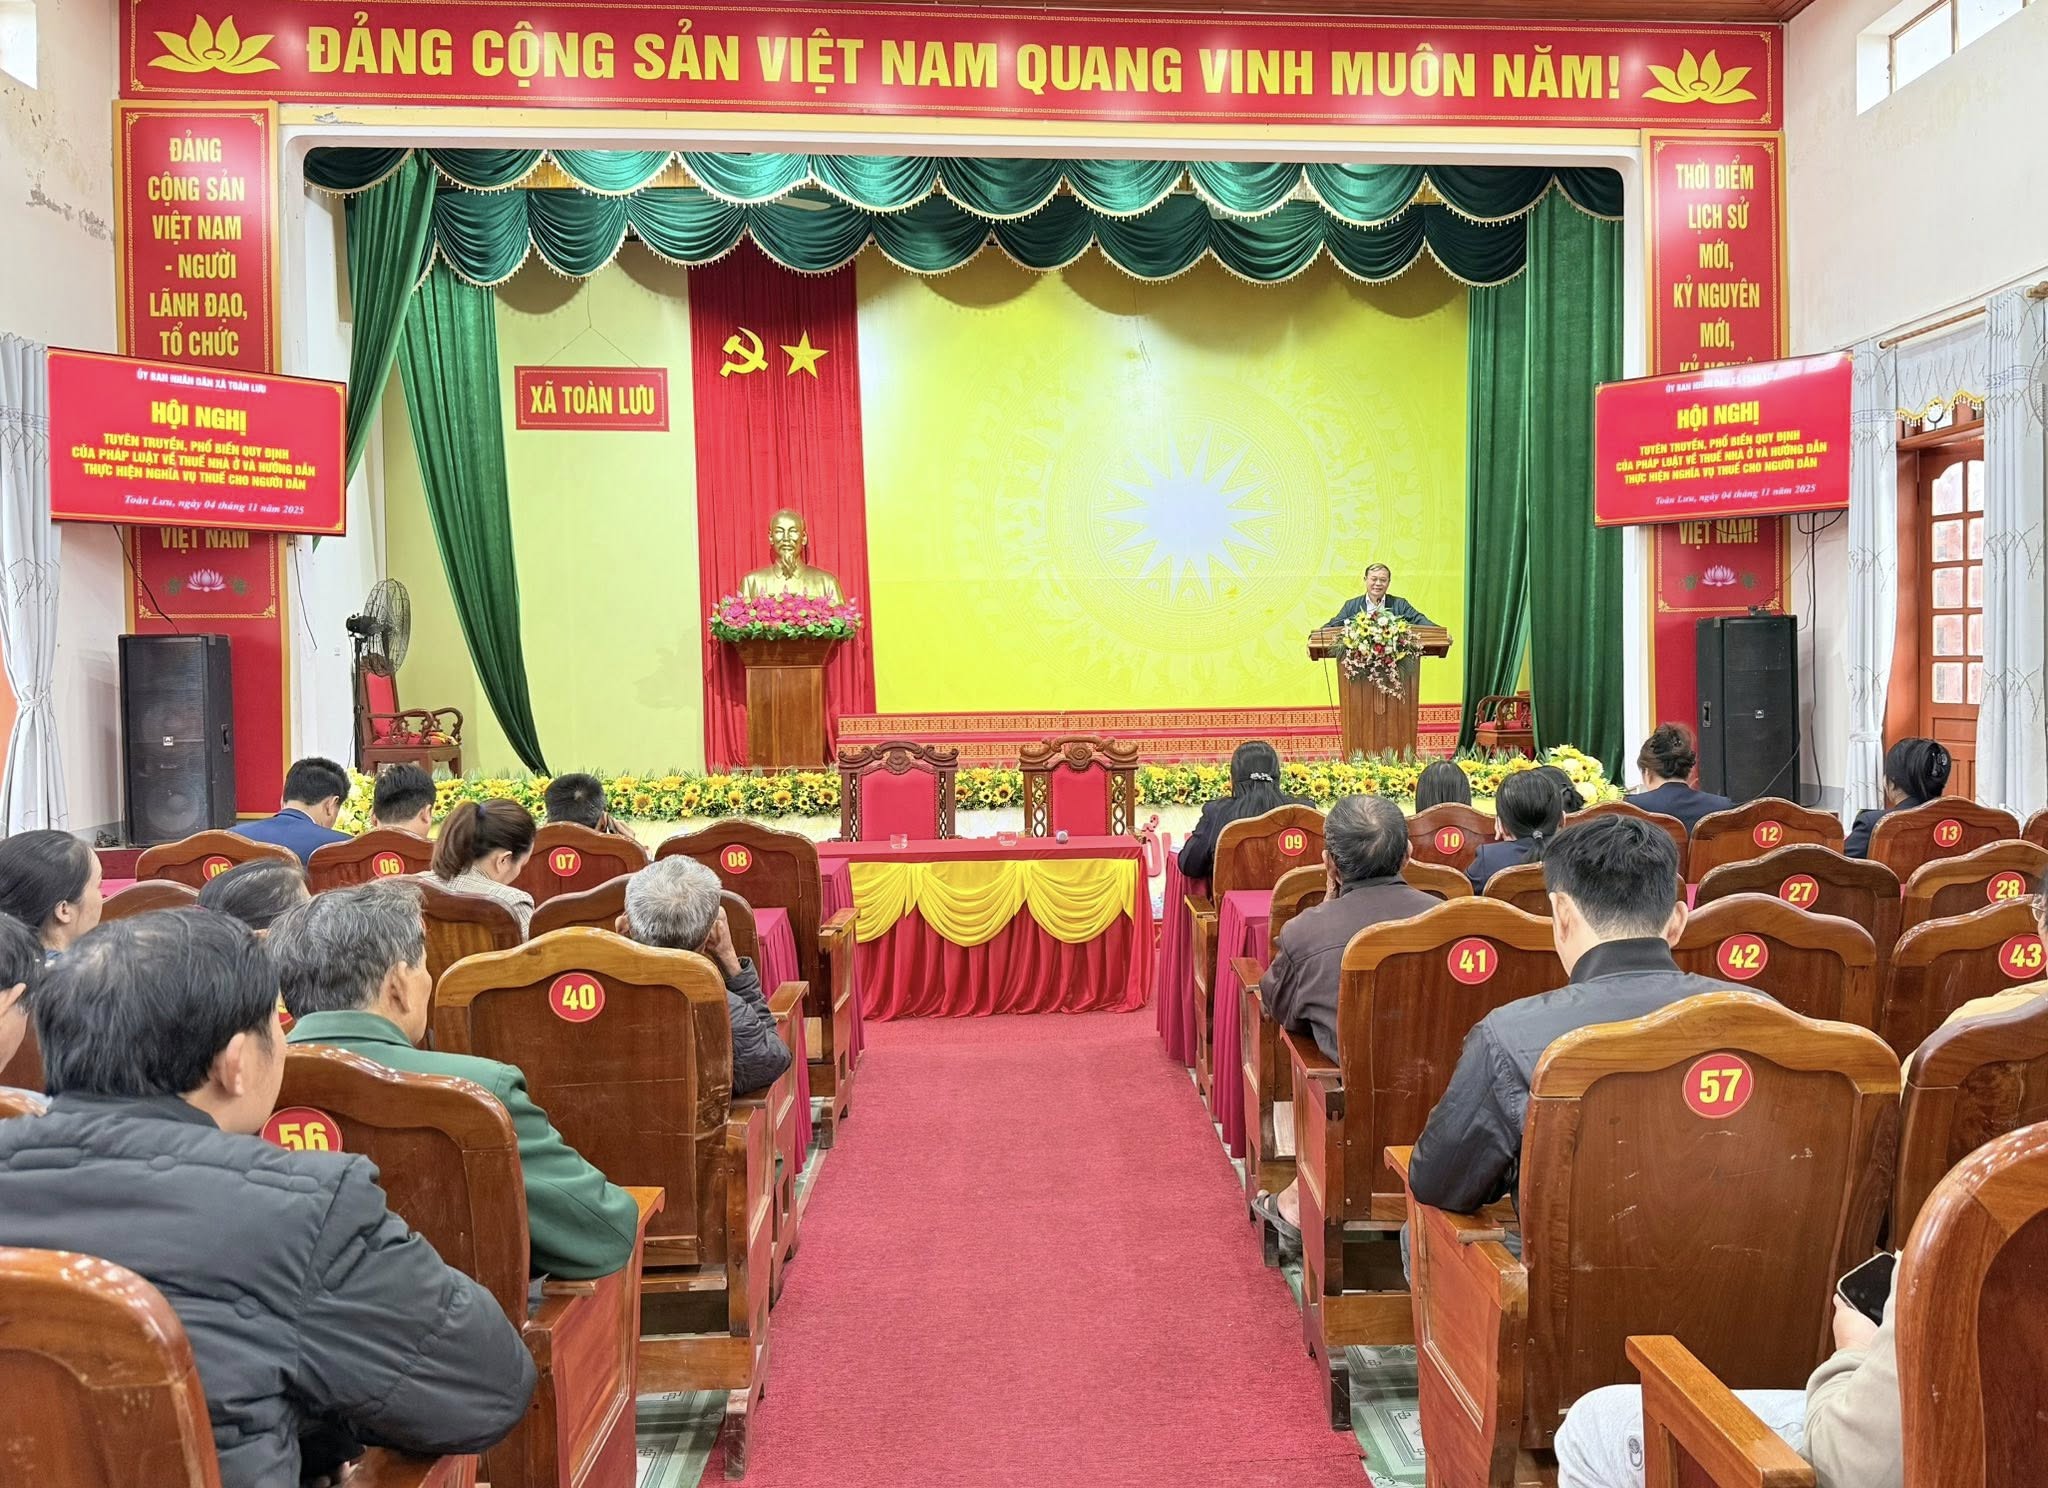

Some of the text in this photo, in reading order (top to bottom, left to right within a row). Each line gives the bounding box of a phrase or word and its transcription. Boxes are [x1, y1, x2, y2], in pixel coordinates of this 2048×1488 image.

[307, 11, 1620, 99] ĐẢNG CỘNG SẢN VIỆT NAM QUANG VINH MUÔN NĂM!
[169, 129, 222, 162] ĐẢNG
[148, 168, 245, 206] CỘNG SẢN
[1676, 155, 1754, 190] THỜI ĐIỂM
[152, 211, 241, 245] VIỆT NAM
[1688, 196, 1749, 234] LỊCH SỬ
[178, 248, 237, 279] NGƯỜI
[1699, 238, 1734, 272] MỚI,
[150, 288, 248, 323] LÃNH ĐẠO,
[1674, 274, 1760, 308] KỶ NGUYÊN
[160, 322, 239, 356] TỔ CHỨC
[1700, 317, 1735, 351] MỚI,
[150, 372, 168, 382] BAN
[530, 380, 655, 415] XÃ TOÀN LƯU
[151, 399, 246, 435] HỘI NGHỊ
[1677, 401, 1759, 432] HỘI NGHỊ
[72, 442, 95, 459] CỦA
[99, 447, 129, 461] PHÁP
[132, 449, 159, 465] LUẬT
[178, 454, 206, 467] THUẾ
[208, 456, 230, 469] NHÀ
[242, 459, 256, 472] VÀ
[103, 433, 138, 446] TUYÊN
[215, 442, 239, 455] BIẾN
[242, 446, 261, 457] QUY
[265, 448, 289, 460] ĐỊNH
[83, 463, 112, 477] THỰC
[116, 466, 142, 479] HIỆN
[182, 472, 196, 484] VỤ
[200, 470, 225, 484] THUẾ
[228, 476, 248, 486] CHO
[285, 477, 306, 490] DÂN
[206, 529, 249, 548] NAM
[1716, 519, 1758, 543] NAM!
[1285, 834, 1303, 850] 09
[1442, 833, 1460, 848] 10
[1761, 826, 1779, 842] 12
[1942, 826, 1958, 841] 13
[379, 858, 400, 874] 06
[555, 853, 576, 870] 07
[727, 851, 748, 868] 08
[1788, 882, 1813, 902] 27
[1995, 879, 2020, 898] 28
[1459, 949, 1487, 974] 41
[1728, 943, 1761, 969] 42
[2010, 943, 2043, 968] 43
[561, 983, 596, 1011] 40
[1698, 1067, 1742, 1104] 57
[278, 1121, 330, 1151] 56
